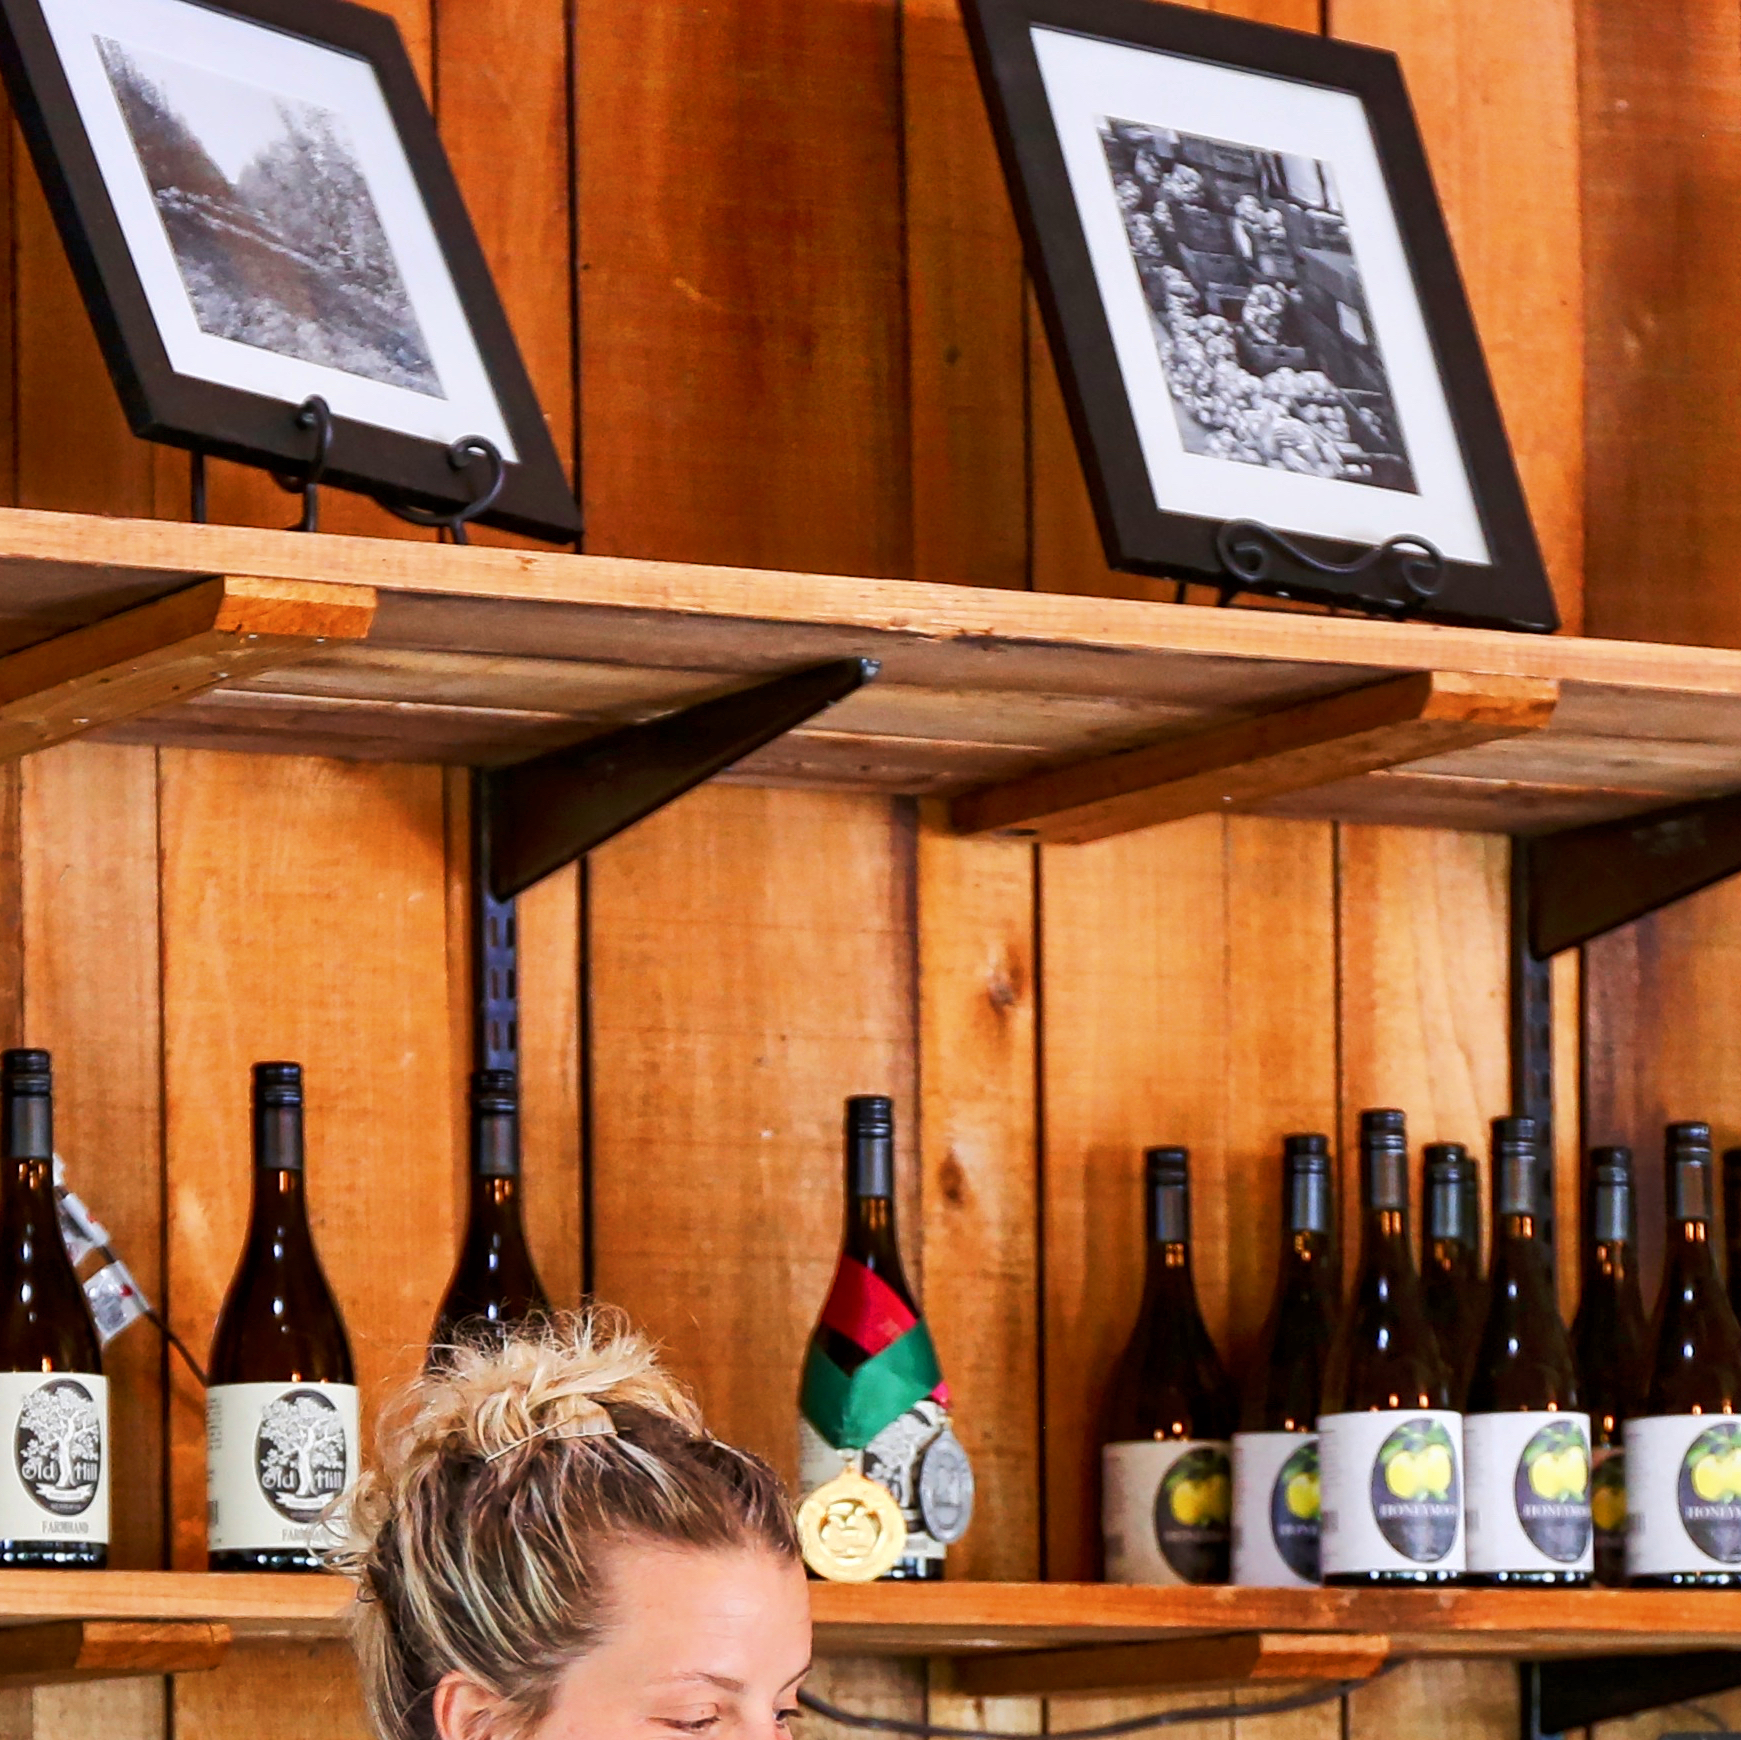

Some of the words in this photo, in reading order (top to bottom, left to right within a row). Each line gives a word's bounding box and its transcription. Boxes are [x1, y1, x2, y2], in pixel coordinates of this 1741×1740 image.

[21, 1459, 56, 1481] Old
[73, 1462, 98, 1481] Hill
[262, 1469, 296, 1489] Old
[315, 1471, 343, 1489] Hill
[1379, 1503, 1457, 1518] HONEYMOO
[41, 1520, 90, 1534] FARMHAND
